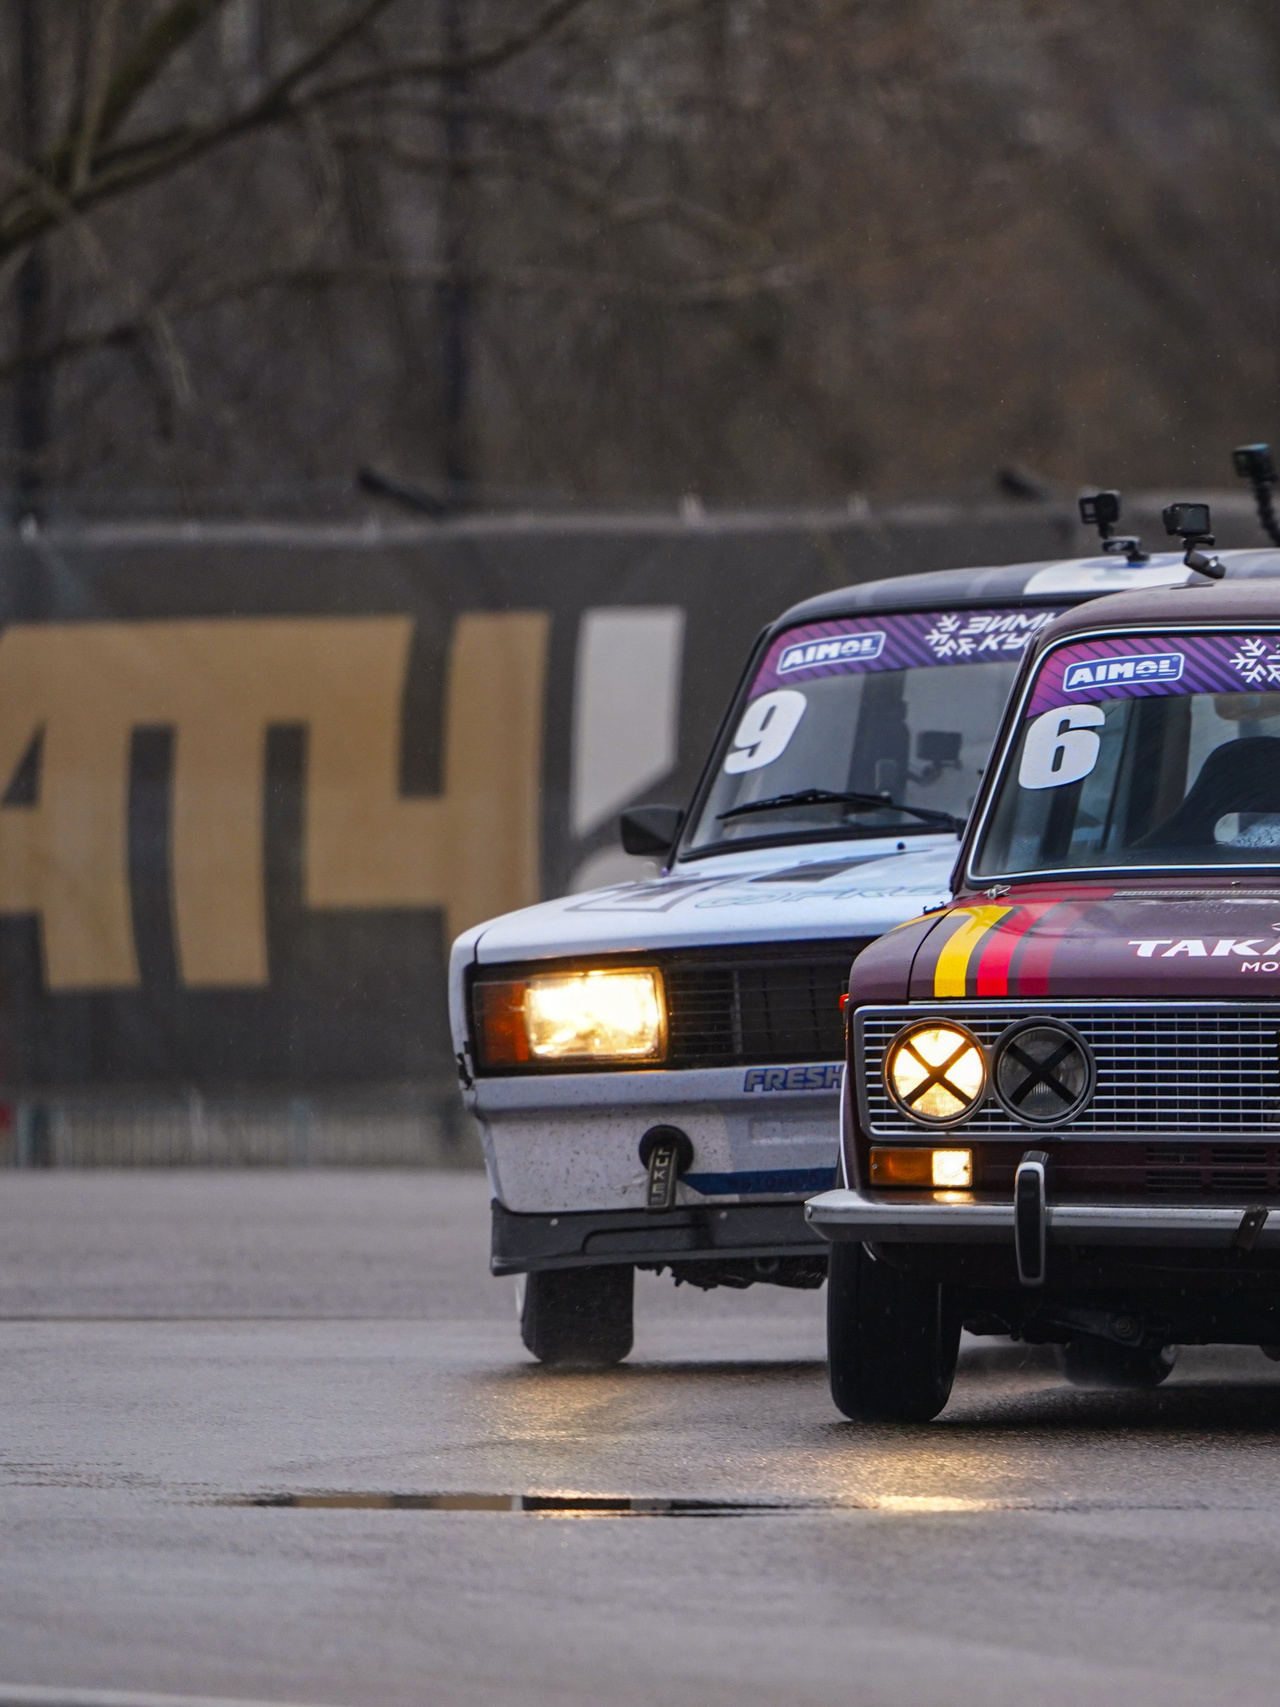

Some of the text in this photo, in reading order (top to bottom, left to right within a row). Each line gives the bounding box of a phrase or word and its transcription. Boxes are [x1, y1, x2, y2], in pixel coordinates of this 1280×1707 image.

[782, 638, 879, 670] AIMOL
[977, 632, 1031, 651] КУ
[1069, 657, 1179, 687] AIMOL
[723, 690, 807, 775] 9
[1018, 704, 1105, 790] 6
[745, 1065, 843, 1091] FRESH
